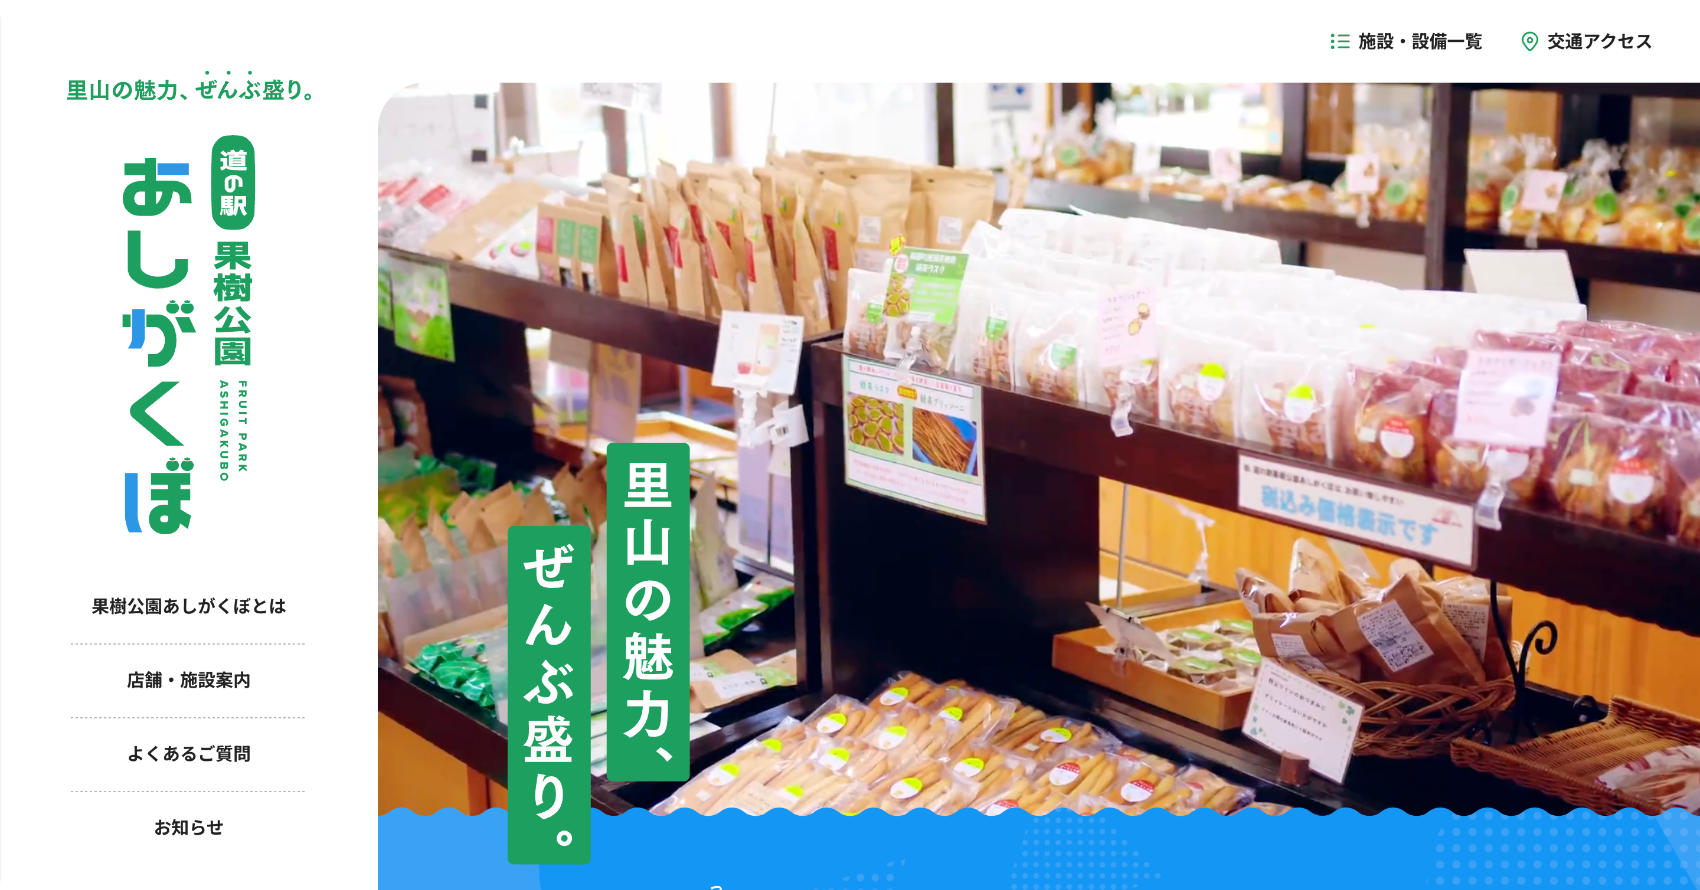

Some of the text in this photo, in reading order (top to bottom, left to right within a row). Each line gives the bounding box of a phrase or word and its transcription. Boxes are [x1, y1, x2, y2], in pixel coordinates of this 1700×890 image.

[1261, 485, 1439, 546] 税込み価格表示です
